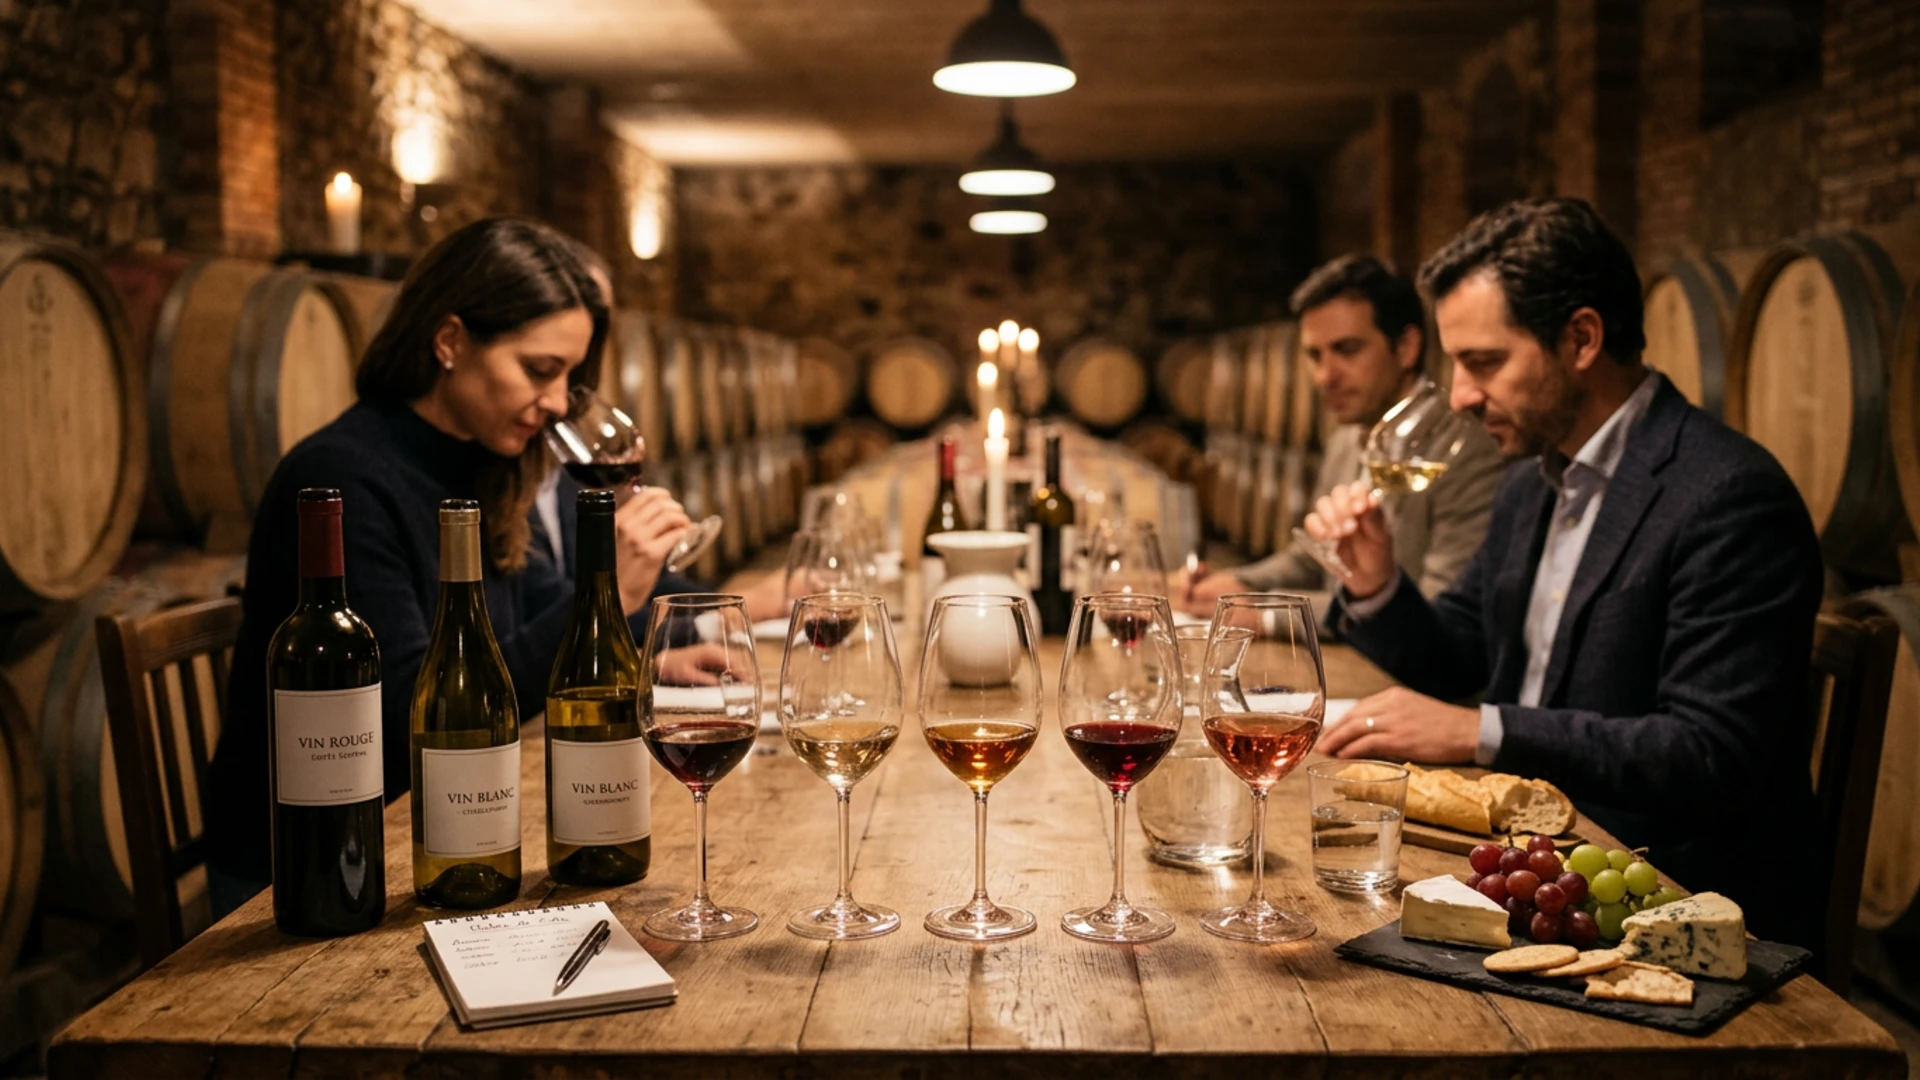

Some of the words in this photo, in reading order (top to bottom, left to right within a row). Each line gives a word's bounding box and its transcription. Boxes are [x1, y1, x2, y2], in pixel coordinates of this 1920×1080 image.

[298, 737, 325, 749] VIN
[329, 731, 375, 748] ROUGE
[571, 783, 595, 794] VIN
[599, 779, 639, 794] BLANC
[447, 793, 473, 804] VIN
[477, 787, 515, 803] BLANC
